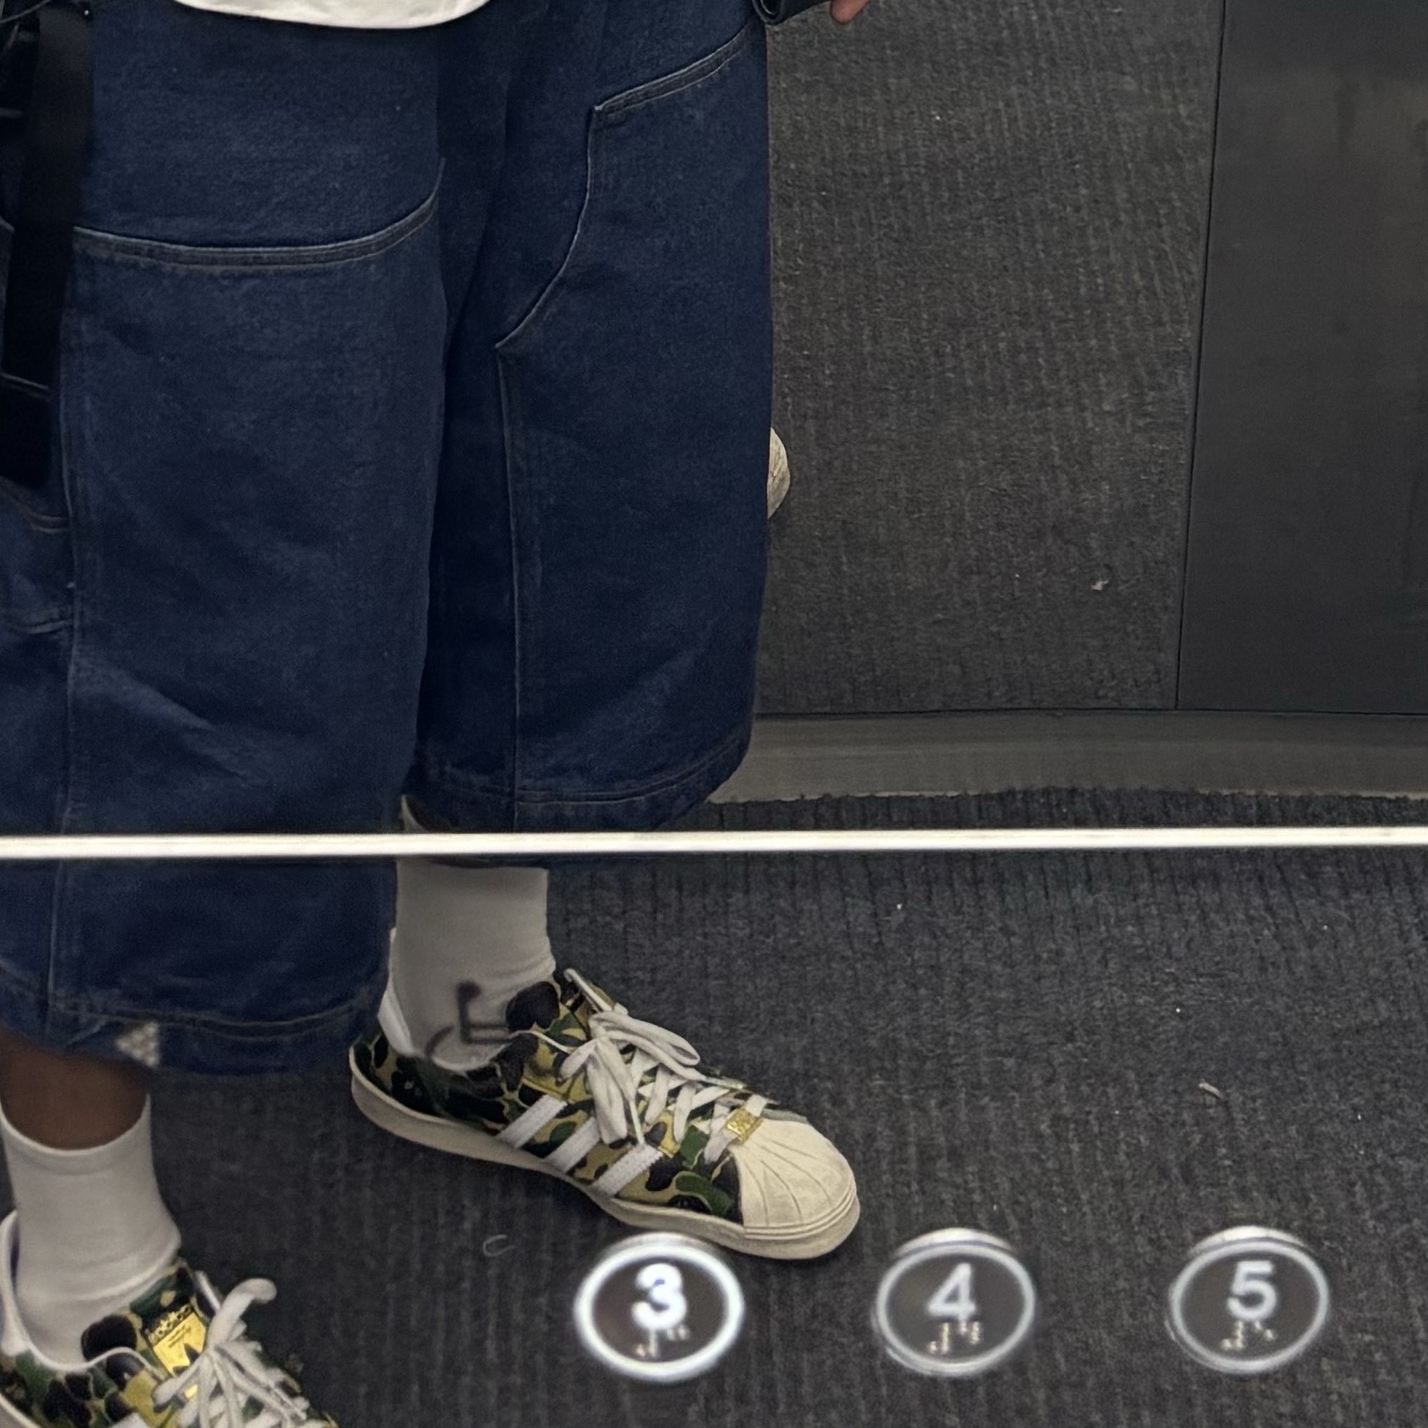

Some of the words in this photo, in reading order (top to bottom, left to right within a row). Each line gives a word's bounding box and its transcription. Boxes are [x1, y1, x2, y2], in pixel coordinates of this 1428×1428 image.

[632, 1263, 687, 1329] 3
[928, 1262, 976, 1321] 4
[1227, 1260, 1277, 1322] 5
